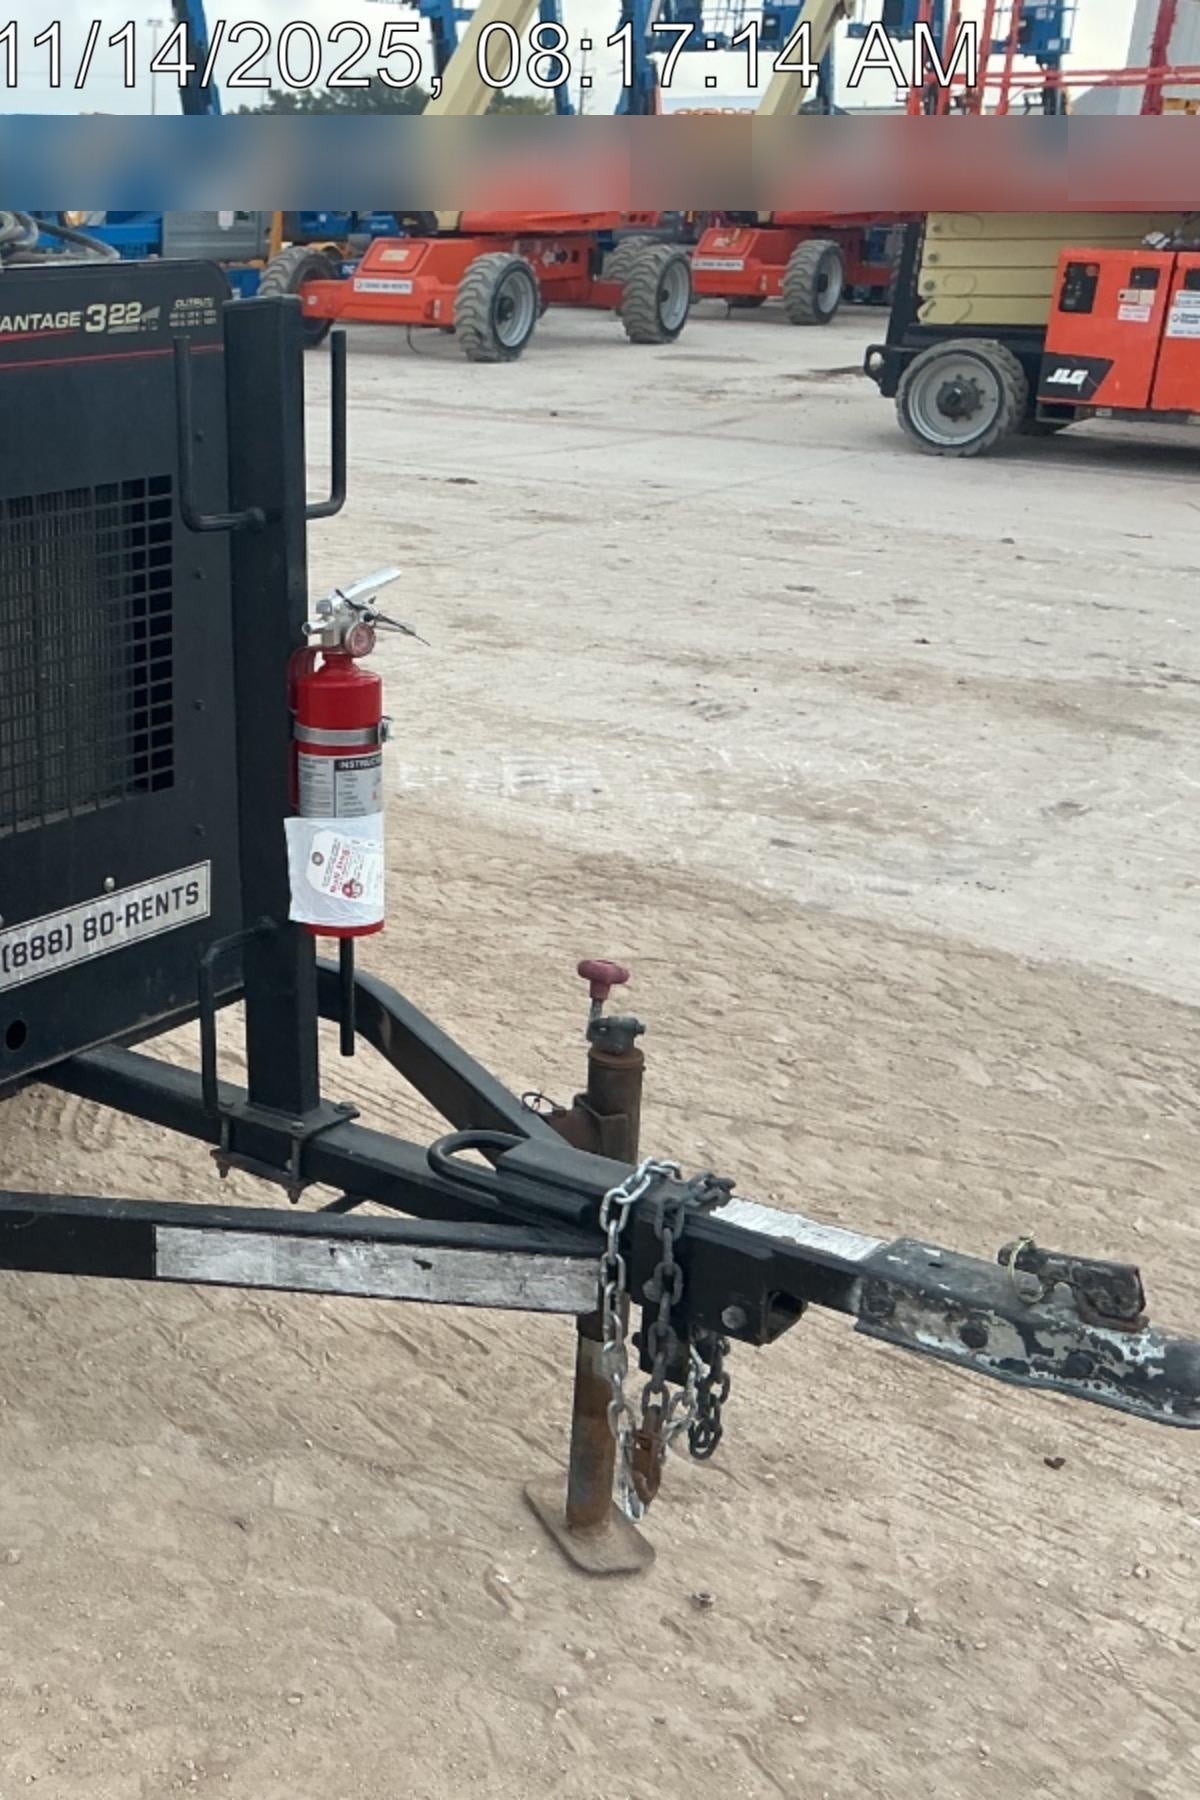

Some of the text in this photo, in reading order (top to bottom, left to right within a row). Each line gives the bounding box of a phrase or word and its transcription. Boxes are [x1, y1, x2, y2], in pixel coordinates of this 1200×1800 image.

[84, 302, 142, 333] 322
[1046, 368, 1089, 386] JLG
[2, 881, 199, 973] (888) 80-RENTS
